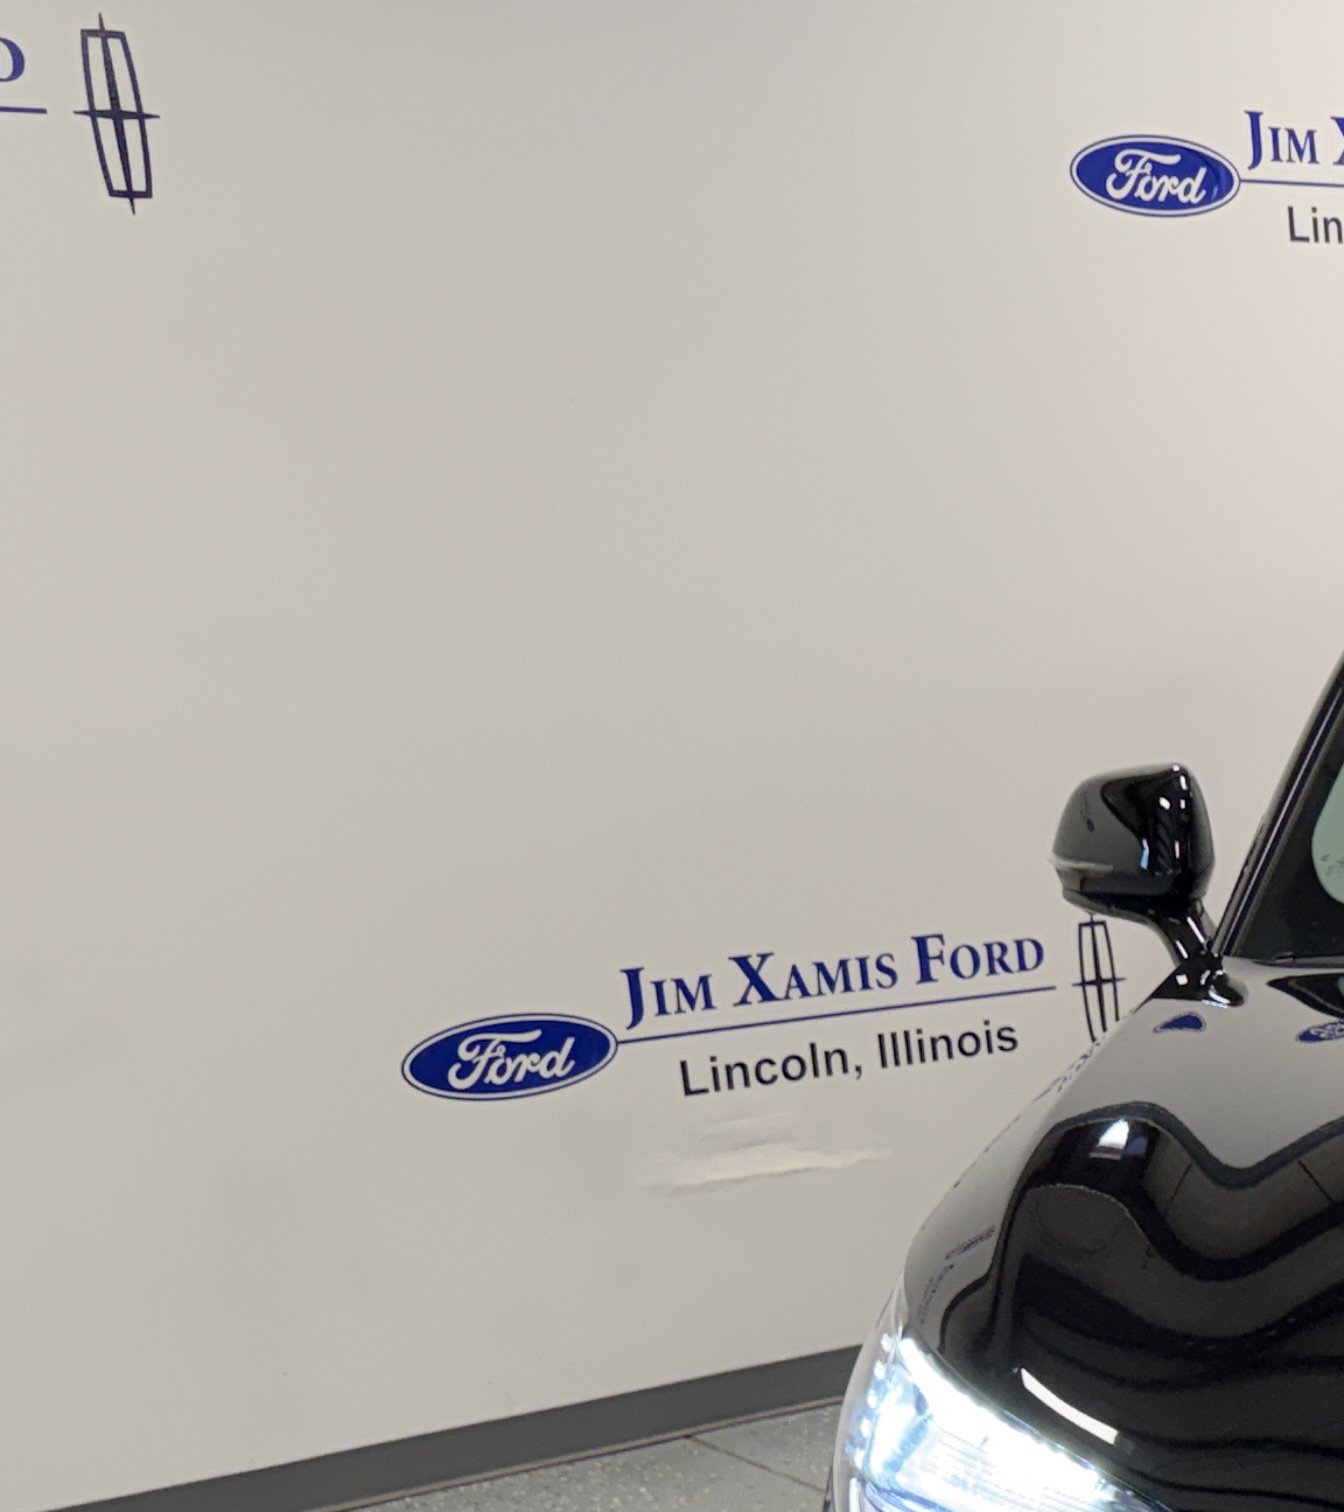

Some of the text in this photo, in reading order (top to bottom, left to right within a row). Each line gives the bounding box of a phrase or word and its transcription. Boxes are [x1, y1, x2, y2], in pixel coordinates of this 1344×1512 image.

[1245, 110, 1319, 170] JIM
[1105, 148, 1206, 204] Ford
[620, 933, 1044, 1030] JIM XAMIS FORD
[445, 1028, 576, 1091] Ford
[679, 1020, 1018, 1097] Lincoln, Illinois
